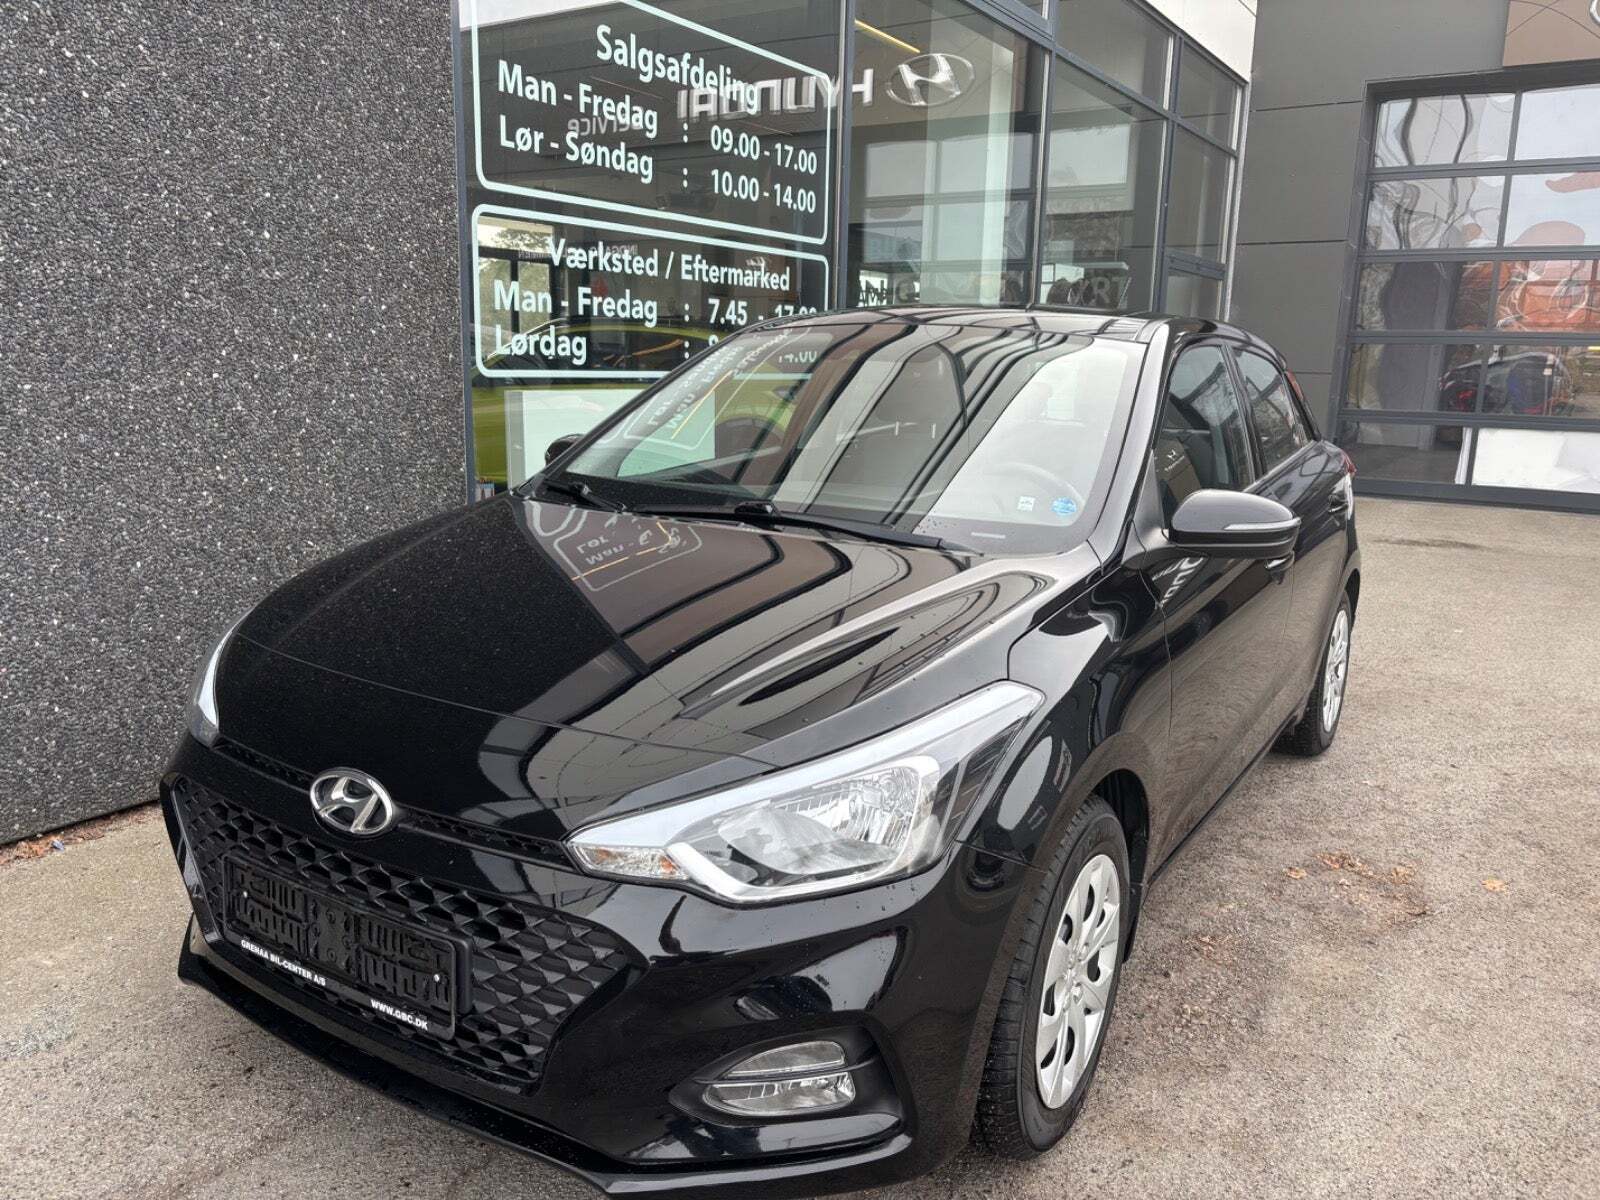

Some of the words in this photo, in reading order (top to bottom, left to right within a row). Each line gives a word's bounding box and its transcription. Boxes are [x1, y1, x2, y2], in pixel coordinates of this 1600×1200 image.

[596, 24, 759, 115] Salgsafdeling
[498, 59, 558, 106] Man
[578, 83, 658, 138] Fredag
[711, 125, 760, 160] 09.00
[775, 143, 817, 175] 17.00
[499, 114, 545, 153] Lør
[565, 131, 653, 183] Søndag
[711, 169, 760, 202] 10.00
[773, 184, 817, 213] 14.00
[549, 238, 658, 278] Værksted
[665, 252, 675, 279] /
[681, 253, 790, 291] Eftermarked
[493, 280, 552, 313] Man
[577, 286, 658, 328] Fredag
[708, 298, 748, 326] 7.45
[496, 324, 587, 365] Lørdag
